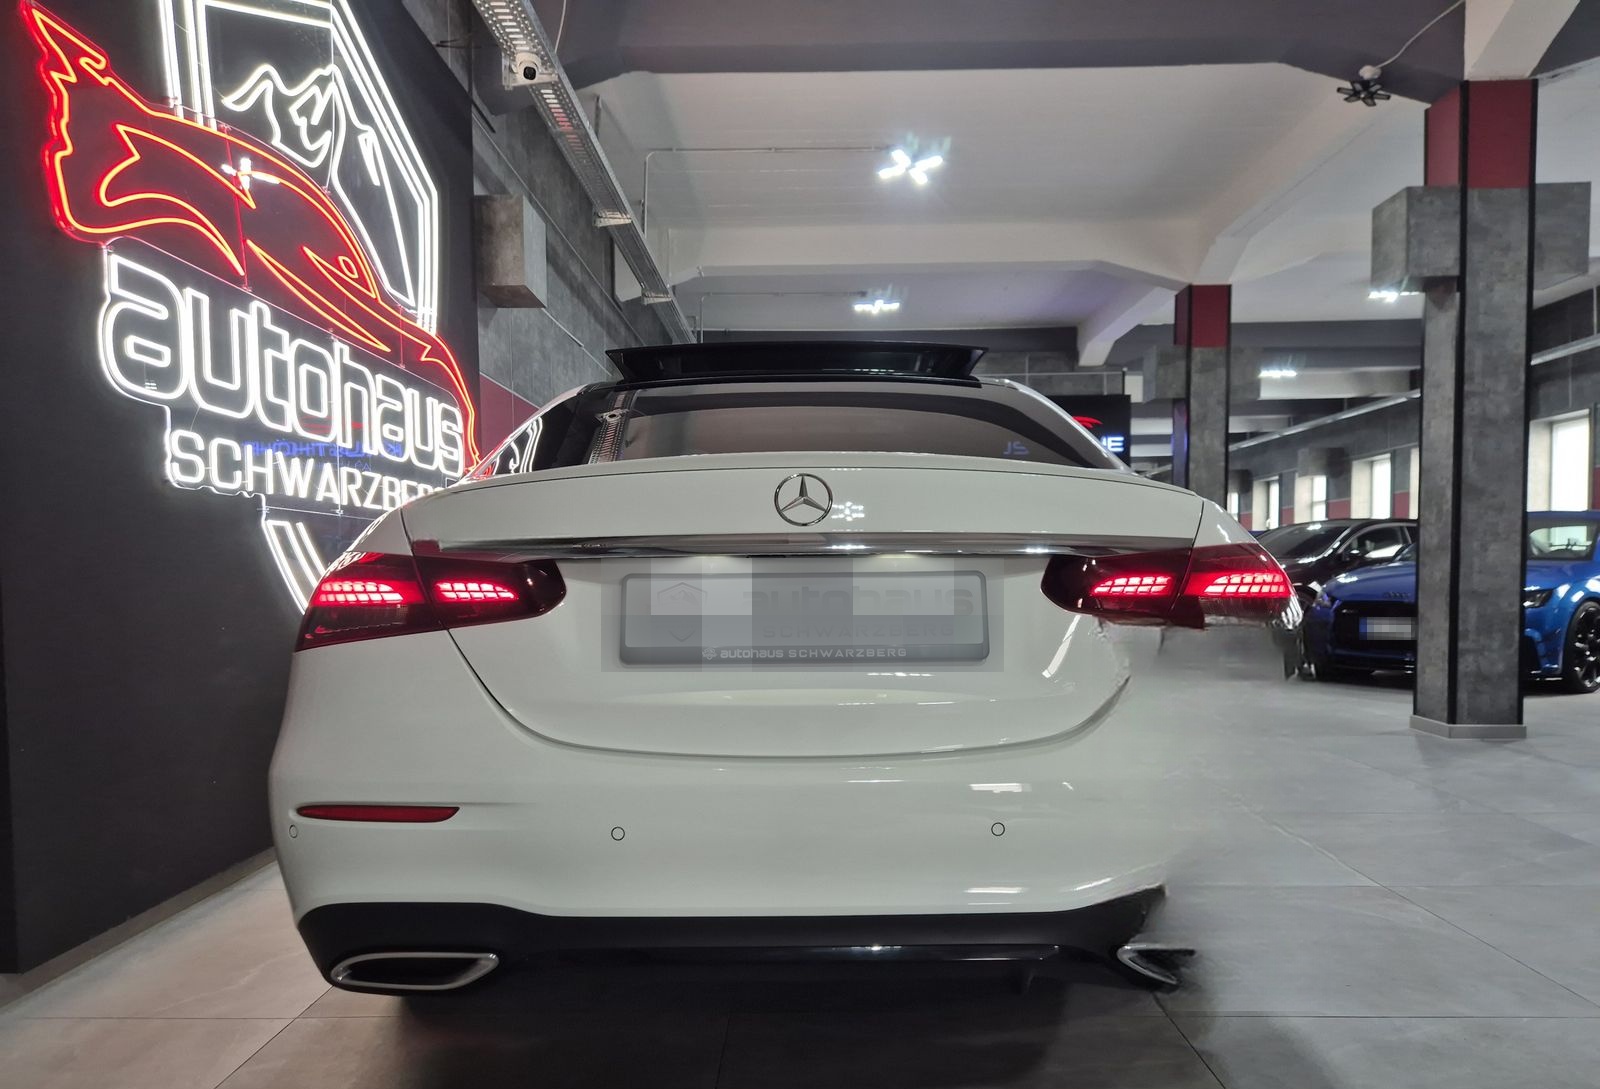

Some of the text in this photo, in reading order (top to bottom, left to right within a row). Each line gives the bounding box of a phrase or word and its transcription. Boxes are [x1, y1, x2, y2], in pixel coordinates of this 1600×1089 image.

[103, 253, 464, 478] autohaus
[170, 429, 446, 512] SCHWARZBE
[742, 586, 974, 615] autohaus
[763, 624, 955, 639] SCHWARZBERG
[720, 648, 907, 659] autohaus SCHWARZBERG
